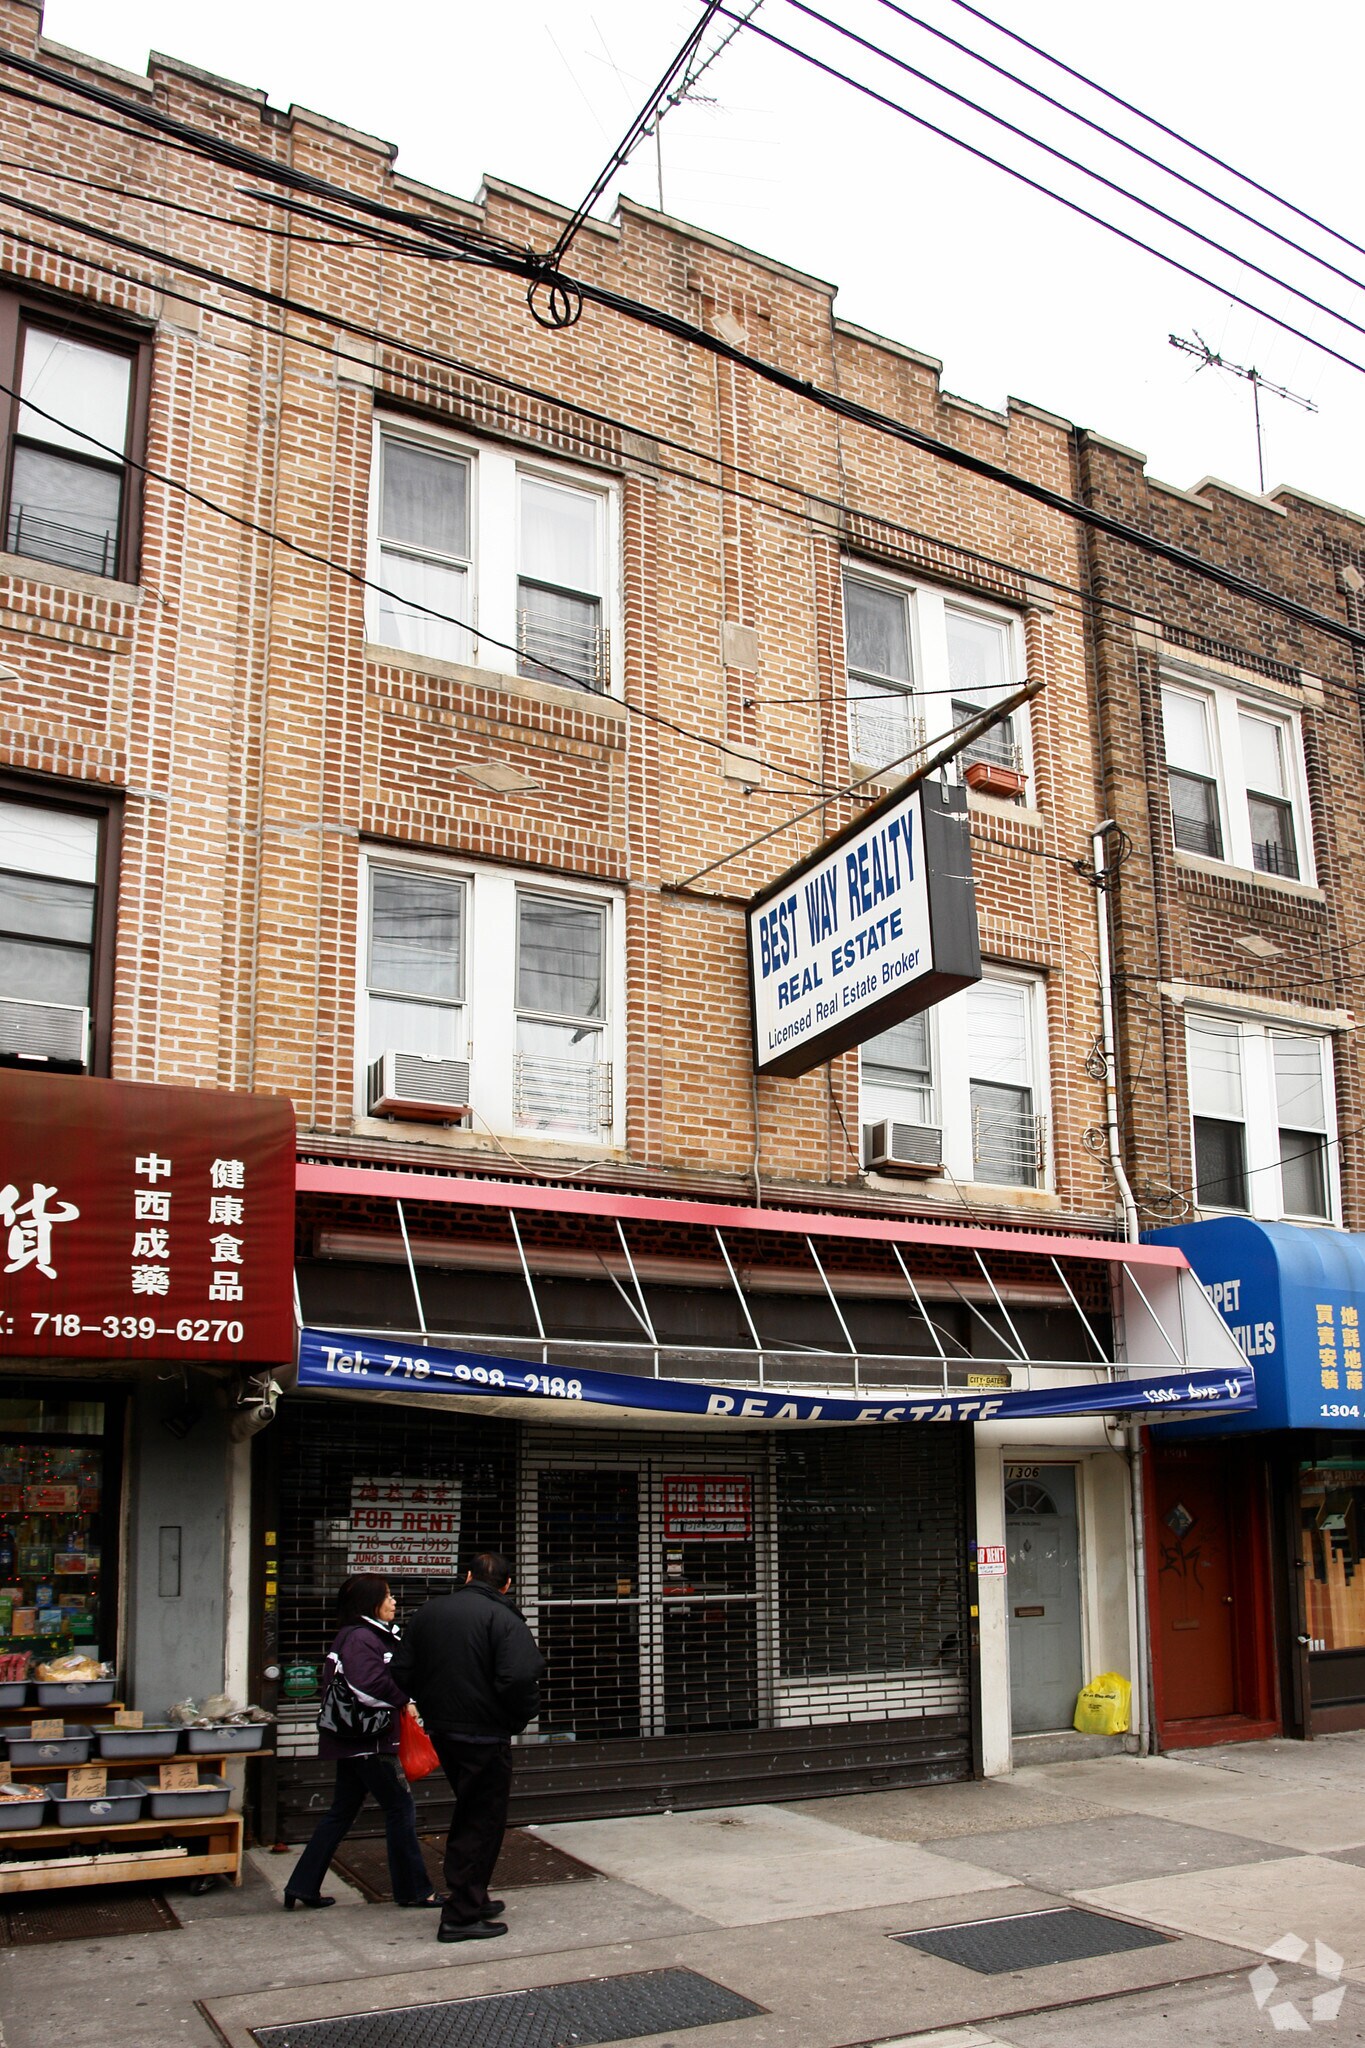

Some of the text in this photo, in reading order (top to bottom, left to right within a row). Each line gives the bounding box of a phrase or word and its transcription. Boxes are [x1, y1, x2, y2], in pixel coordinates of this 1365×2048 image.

[759, 809, 914, 979] BEST WAY REALTY
[778, 907, 903, 1009] REAL ESTATE
[768, 948, 920, 1049] Licensed Real Estate Broker
[131, 1153, 172, 1296] 中西成藥
[208, 1158, 245, 1301] 健康食品
[30, 1312, 244, 1343] 718-339-6270
[321, 1345, 583, 1400] Tel: 718-998-2188
[1143, 1379, 1241, 1403] 1306 Ave. U
[1320, 1404, 1360, 1417] 1304
[1008, 1467, 1040, 1478] 1306
[668, 1484, 746, 1513] FOR RENT
[353, 1509, 457, 1533] FOR RENT
[389, 1555, 413, 1564] REAL
[417, 1556, 452, 1564] ESTATE
